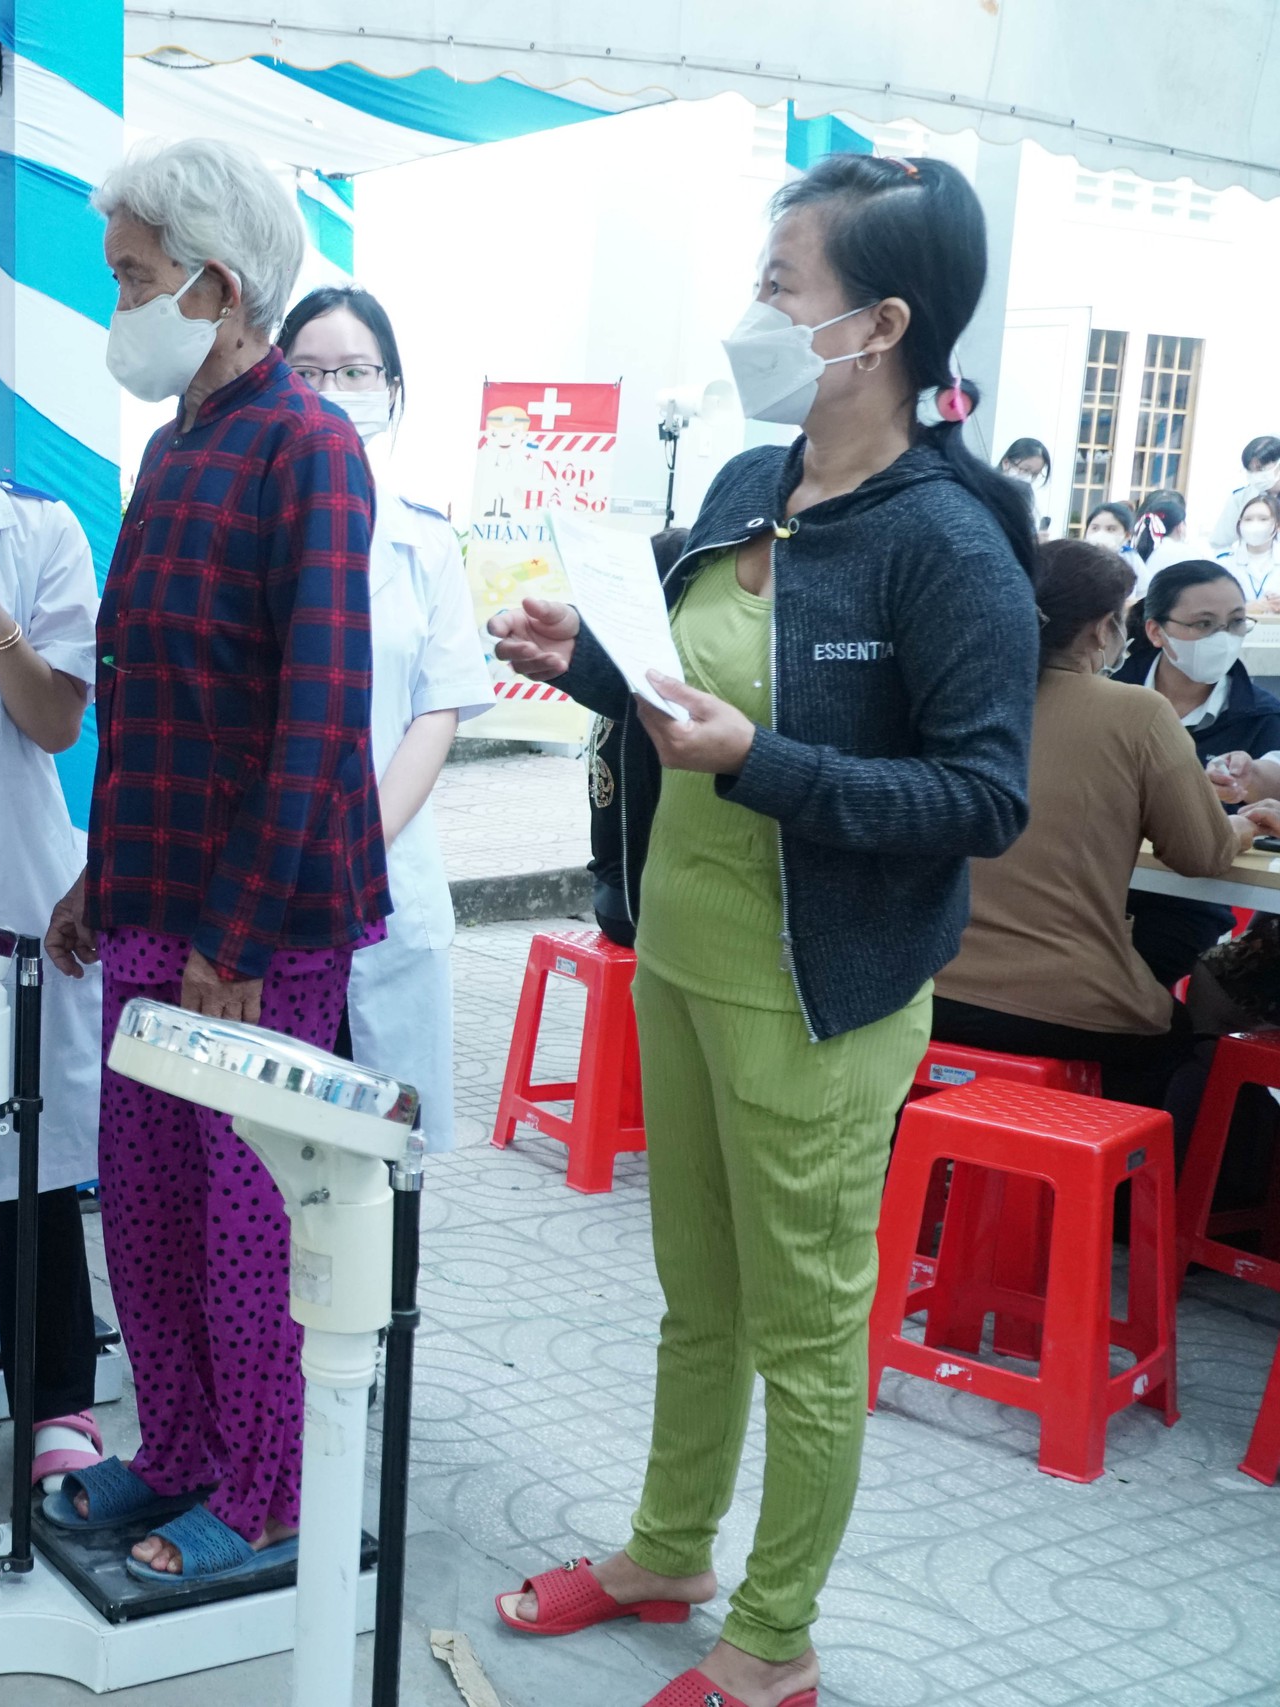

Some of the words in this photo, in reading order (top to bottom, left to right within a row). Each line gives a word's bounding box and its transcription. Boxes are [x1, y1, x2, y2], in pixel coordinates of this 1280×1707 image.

[541, 460, 595, 487] Nộp
[573, 491, 607, 513] Sơ
[471, 520, 530, 544] NHẬN
